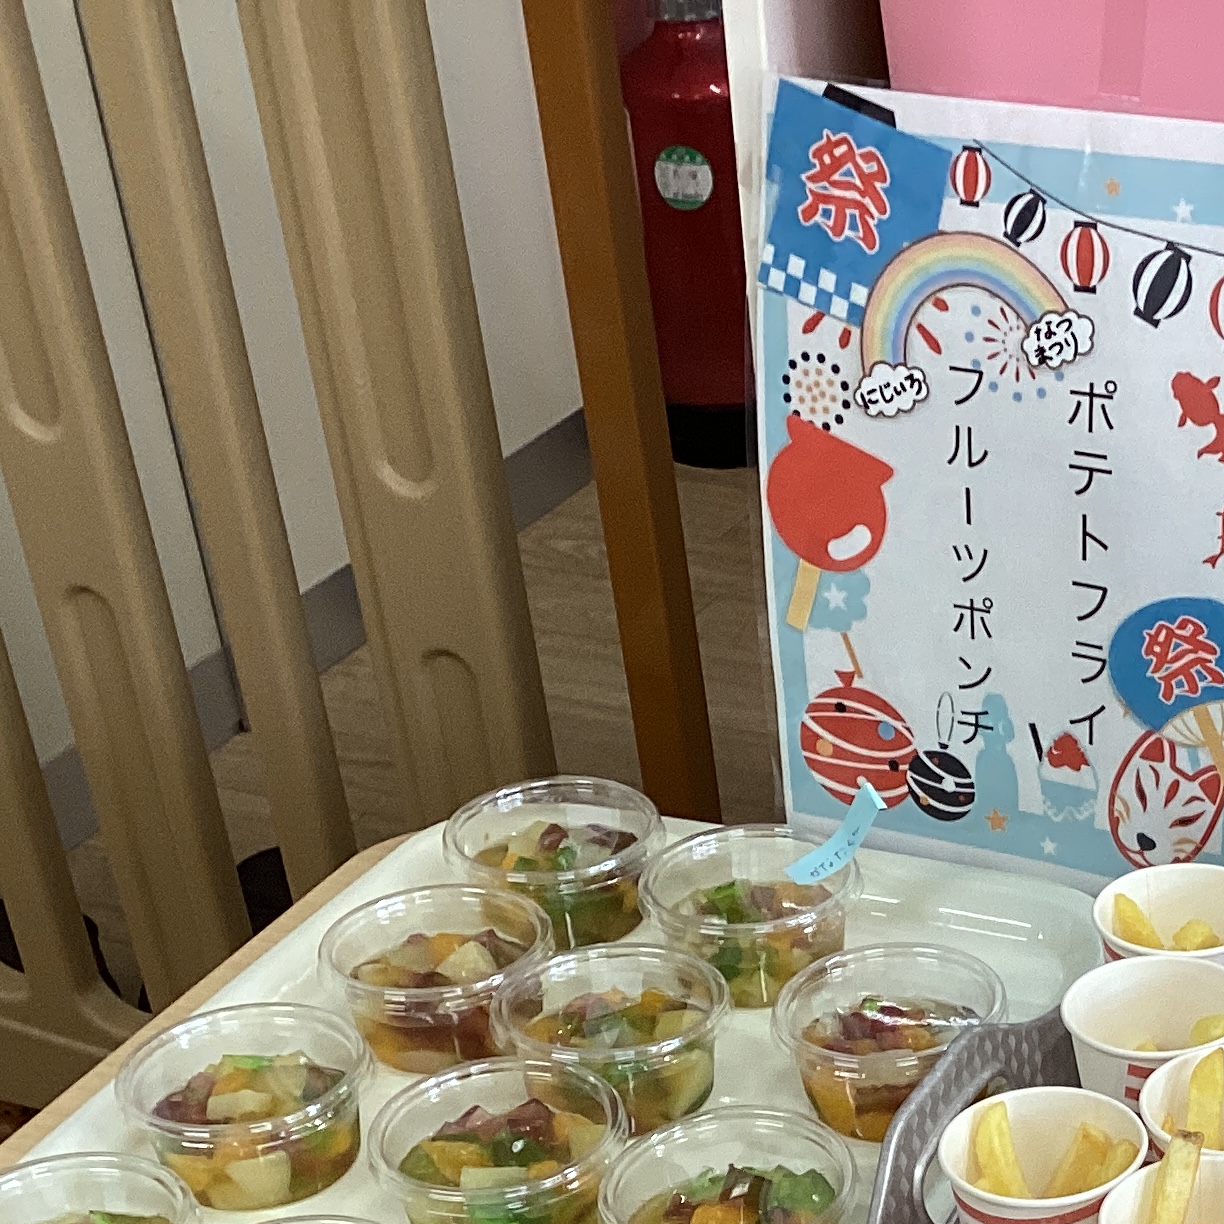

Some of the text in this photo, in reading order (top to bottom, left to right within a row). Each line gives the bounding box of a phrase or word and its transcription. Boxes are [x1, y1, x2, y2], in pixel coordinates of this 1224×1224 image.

[799, 130, 888, 252] 祭
[1034, 320, 1072, 341] なつ
[1034, 332, 1079, 365] まつり
[860, 373, 923, 409] にじいろ
[947, 365, 994, 745] フルーツポンチ
[1067, 380, 1118, 745] ポテトフライ
